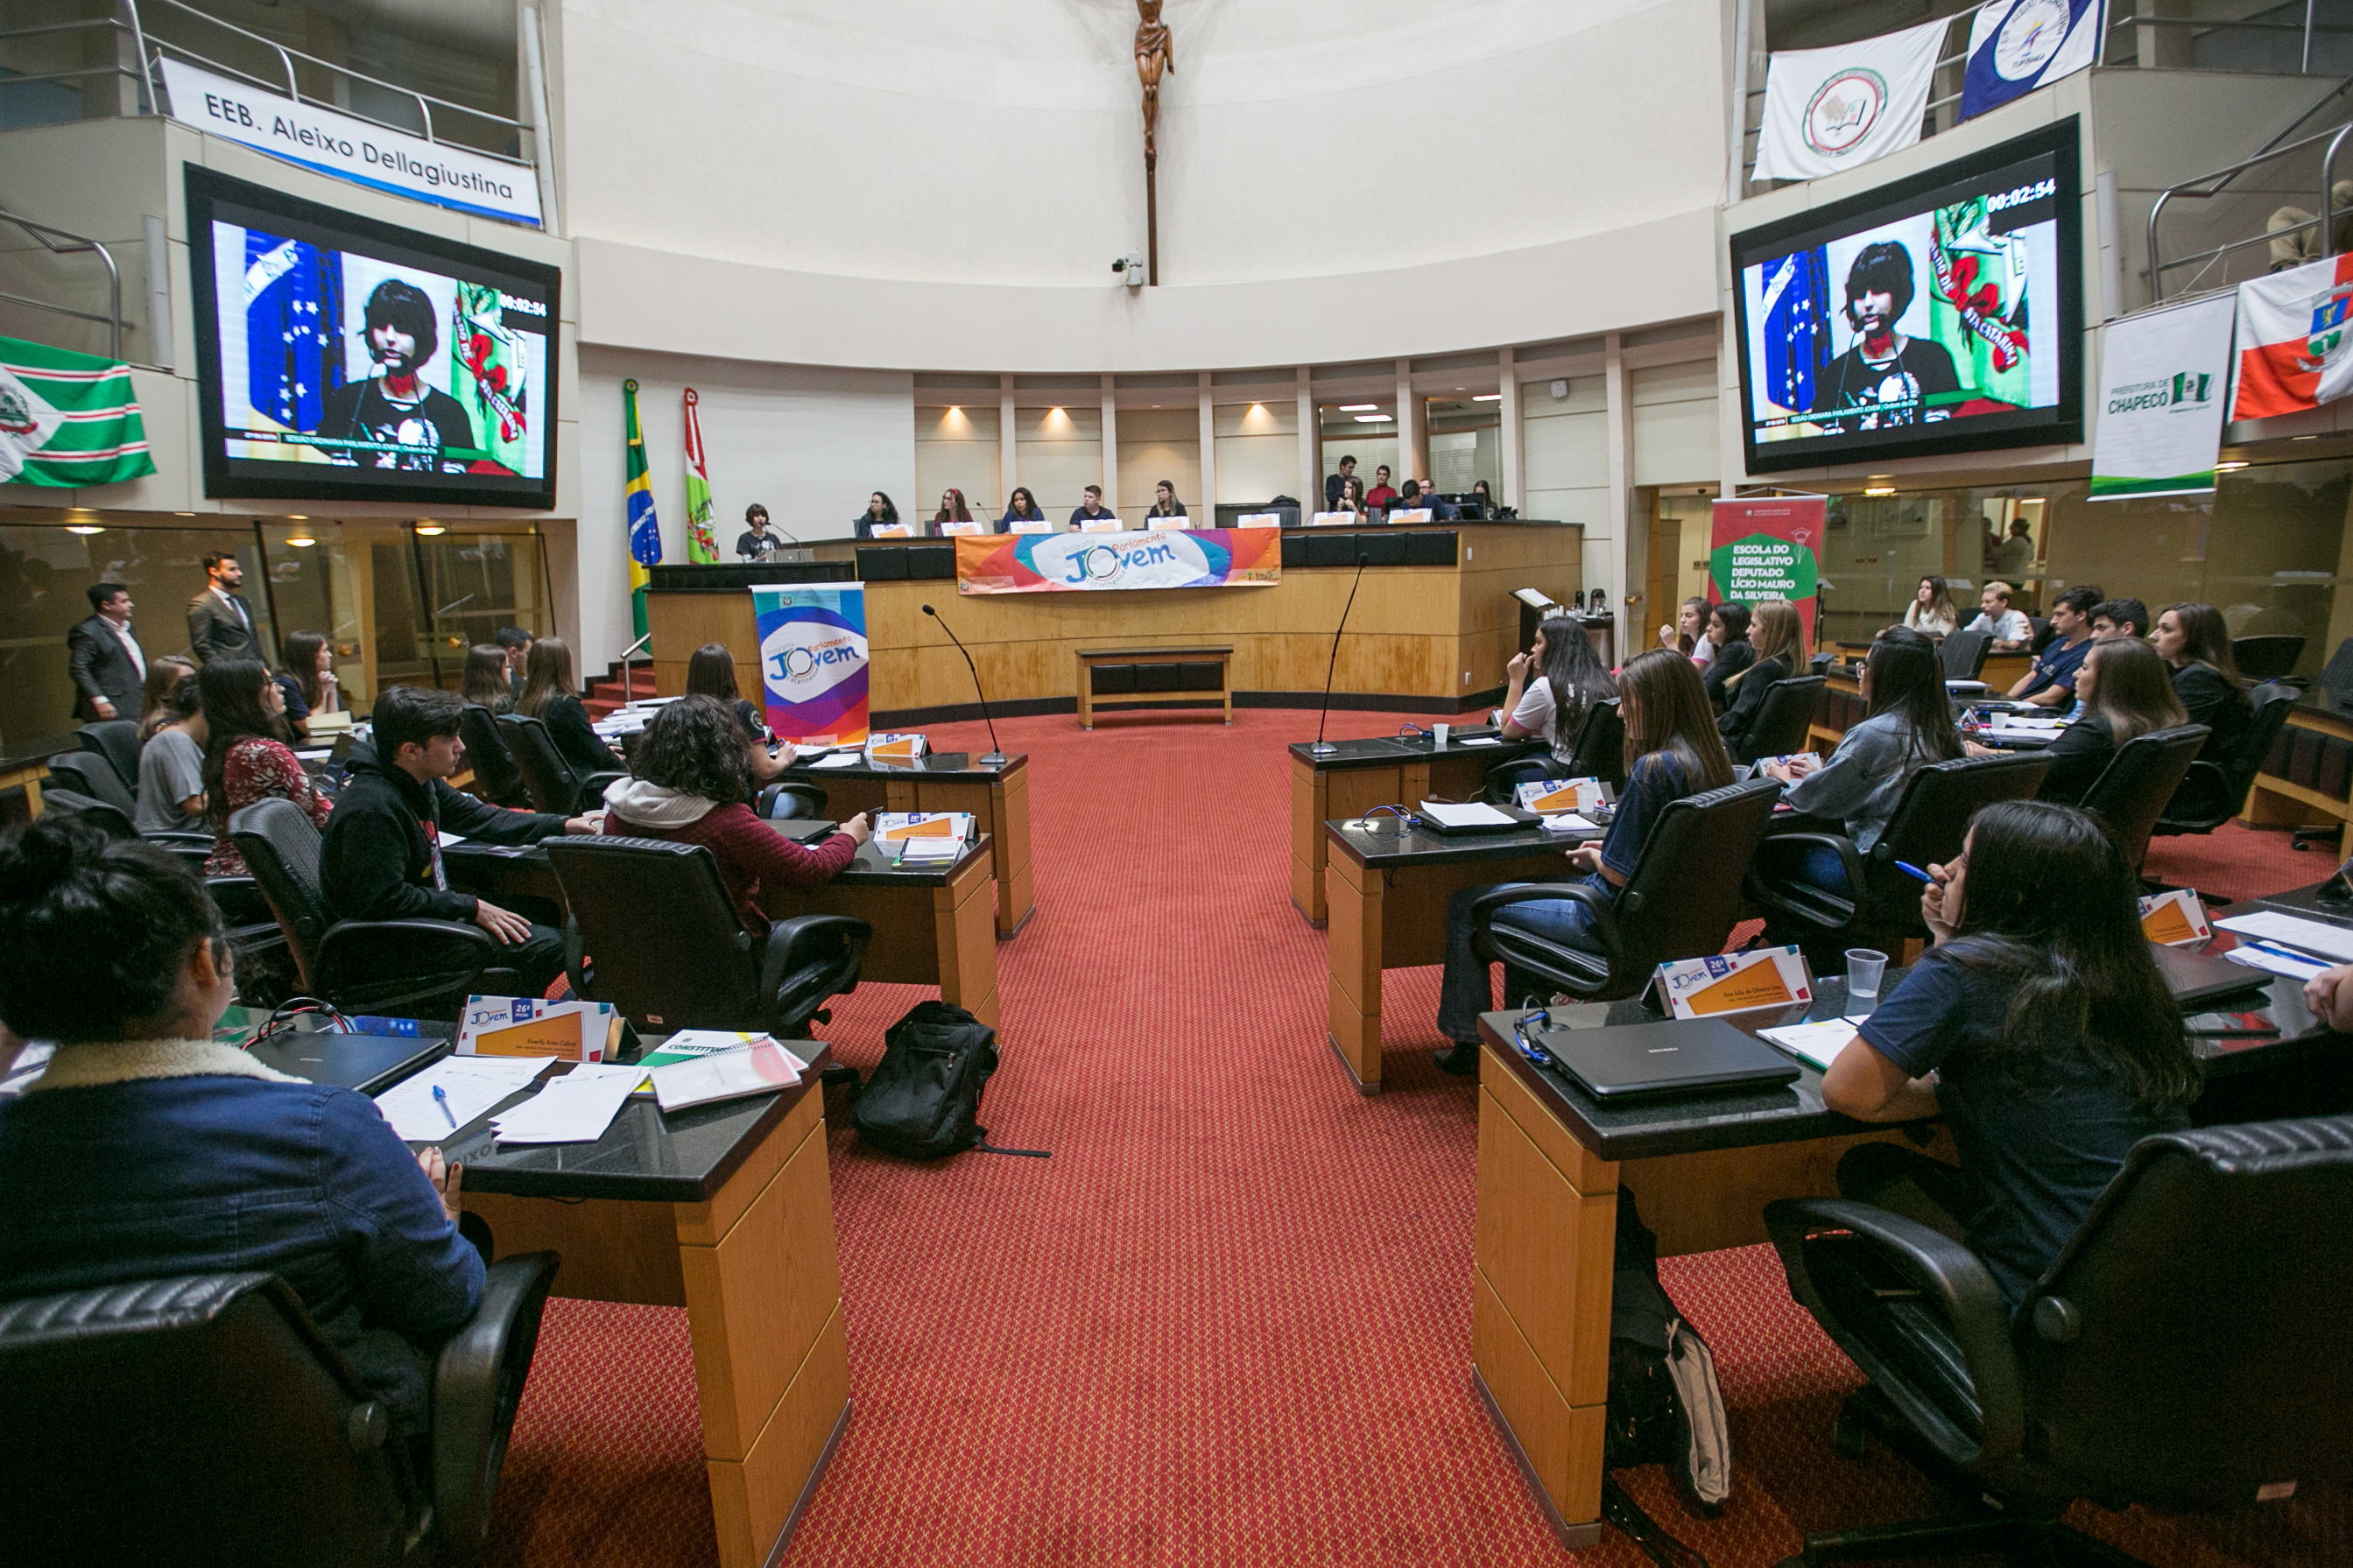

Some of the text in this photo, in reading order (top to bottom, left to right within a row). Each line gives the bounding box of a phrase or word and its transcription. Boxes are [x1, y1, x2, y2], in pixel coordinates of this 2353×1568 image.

[204, 92, 513, 200] EEB. Aleixo Dellagiustina
[1986, 178, 2056, 214] 00:02:54
[499, 294, 547, 318] 00:02:54
[2110, 377, 2170, 396] PREFEITURA DE
[2108, 388, 2169, 414] CHAPECÓ
[1832, 406, 1863, 418] PARLAMENTO
[1864, 404, 1881, 413] JOVEM
[1062, 538, 1096, 555] Programa
[1111, 531, 1166, 552] Parlamento
[1733, 545, 1789, 554] ESCOLA DO
[1732, 556, 1793, 566] LEGISLATIVO
[1086, 569, 1127, 588] catarinense
[1731, 568, 1784, 577] DEPUTADO
[1730, 577, 1795, 589] LÍCIO MAURO
[1730, 591, 1786, 601] DA SILVEIRA
[766, 642, 795, 656] Programa
[807, 636, 852, 652] Parlamento
[787, 667, 820, 684] catarinense
[668, 1044, 727, 1053] CONSTITU
